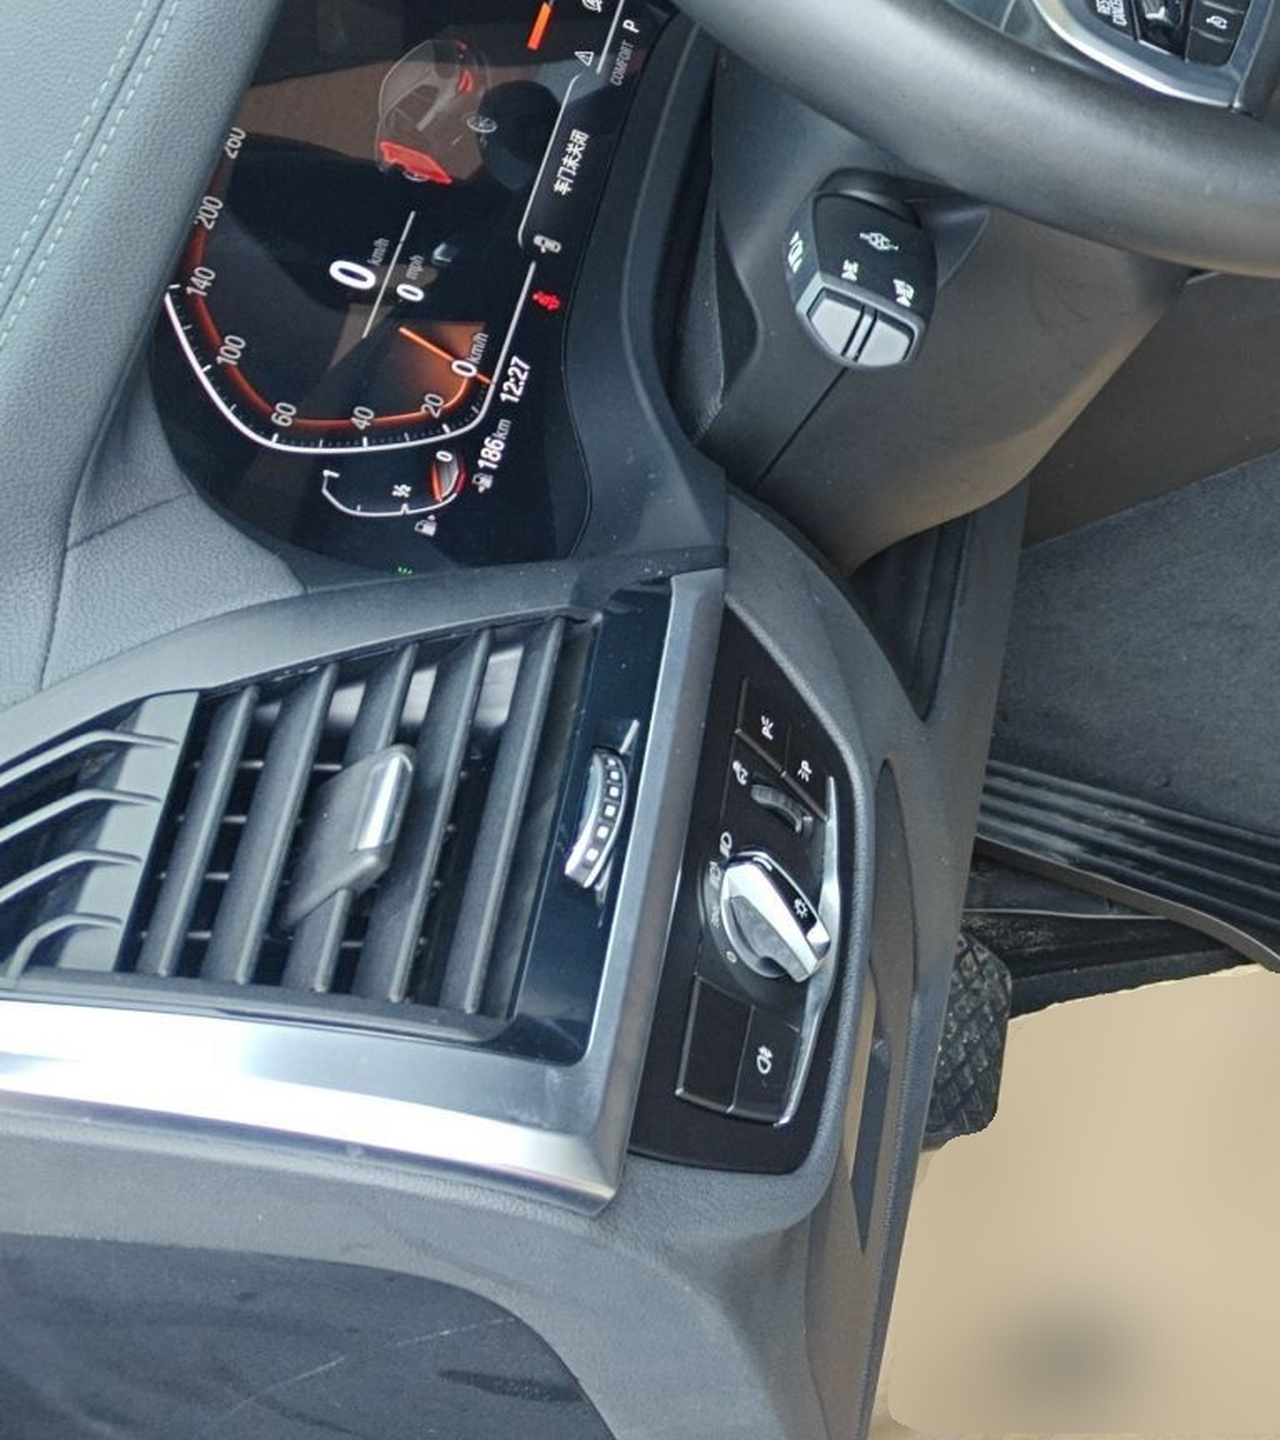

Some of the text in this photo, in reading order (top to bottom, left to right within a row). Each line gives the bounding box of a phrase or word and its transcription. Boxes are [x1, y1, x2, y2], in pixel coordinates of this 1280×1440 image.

[623, 19, 640, 33] P
[610, 40, 634, 86] COMFORT
[553, 128, 590, 196] 车门未关闭
[198, 196, 224, 230] 200
[329, 237, 390, 290] 0 km/h
[396, 254, 424, 302] 0 mph
[186, 266, 216, 297] 140
[217, 334, 246, 366] 100
[500, 355, 532, 404] 12:27
[271, 402, 297, 427] 60
[351, 406, 375, 430] 40
[421, 393, 445, 418] 20
[436, 450, 453, 463] 0
